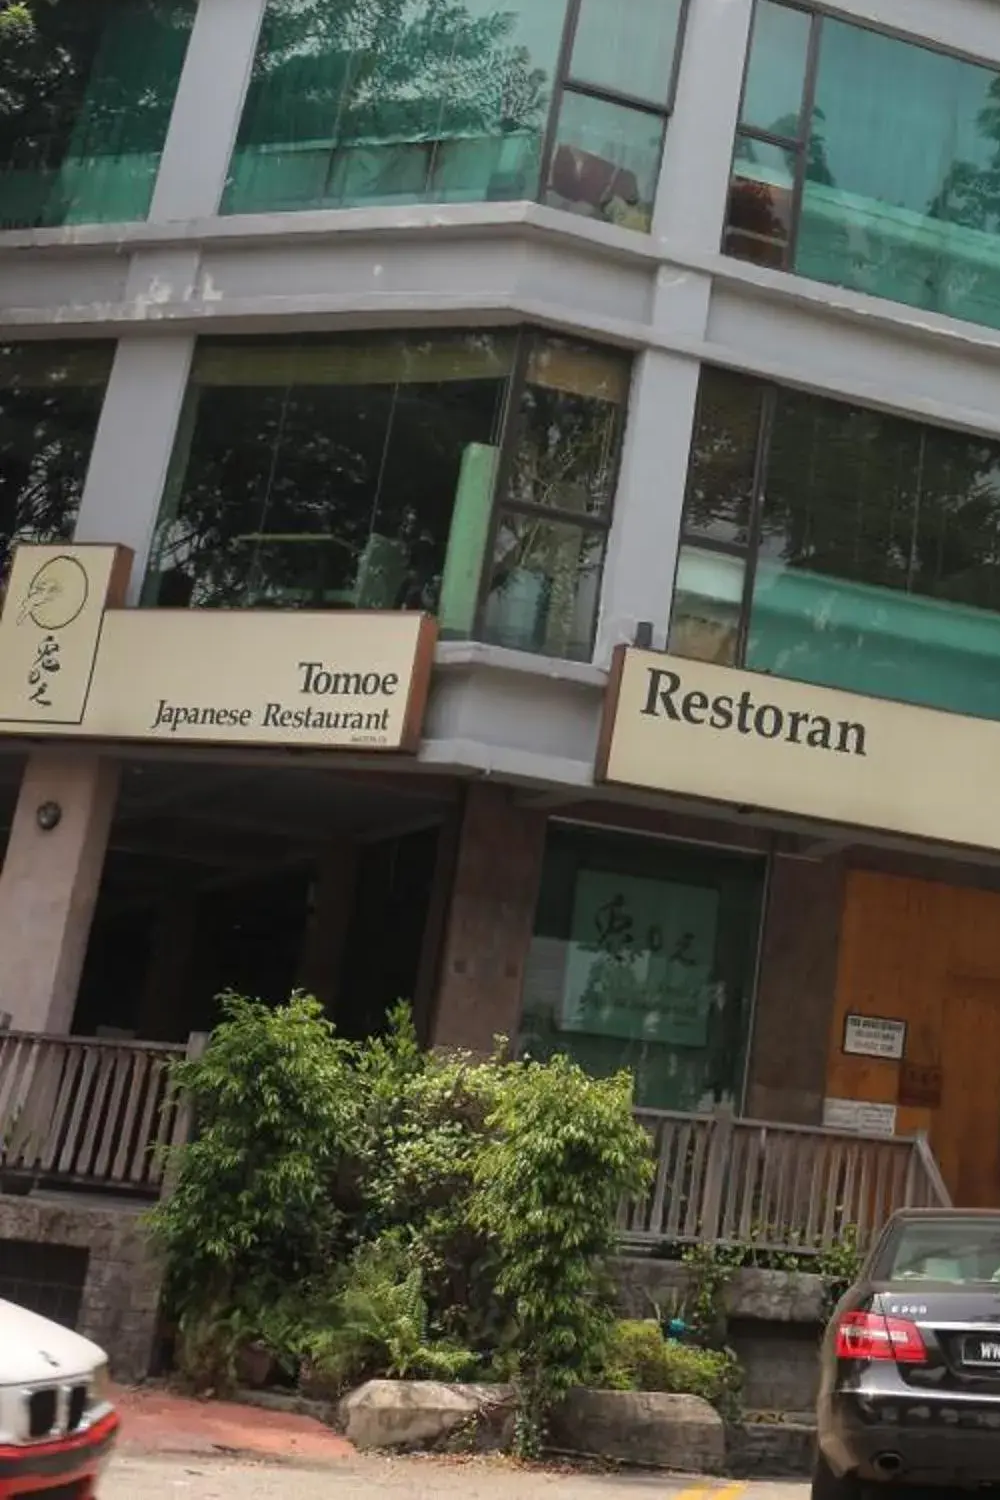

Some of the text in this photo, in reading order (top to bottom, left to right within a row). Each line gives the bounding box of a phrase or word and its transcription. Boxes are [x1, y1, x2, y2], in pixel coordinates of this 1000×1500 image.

[299, 662, 399, 696] Tomoe
[152, 699, 390, 731] Japanese Restaurant
[639, 666, 868, 757] Restoran
